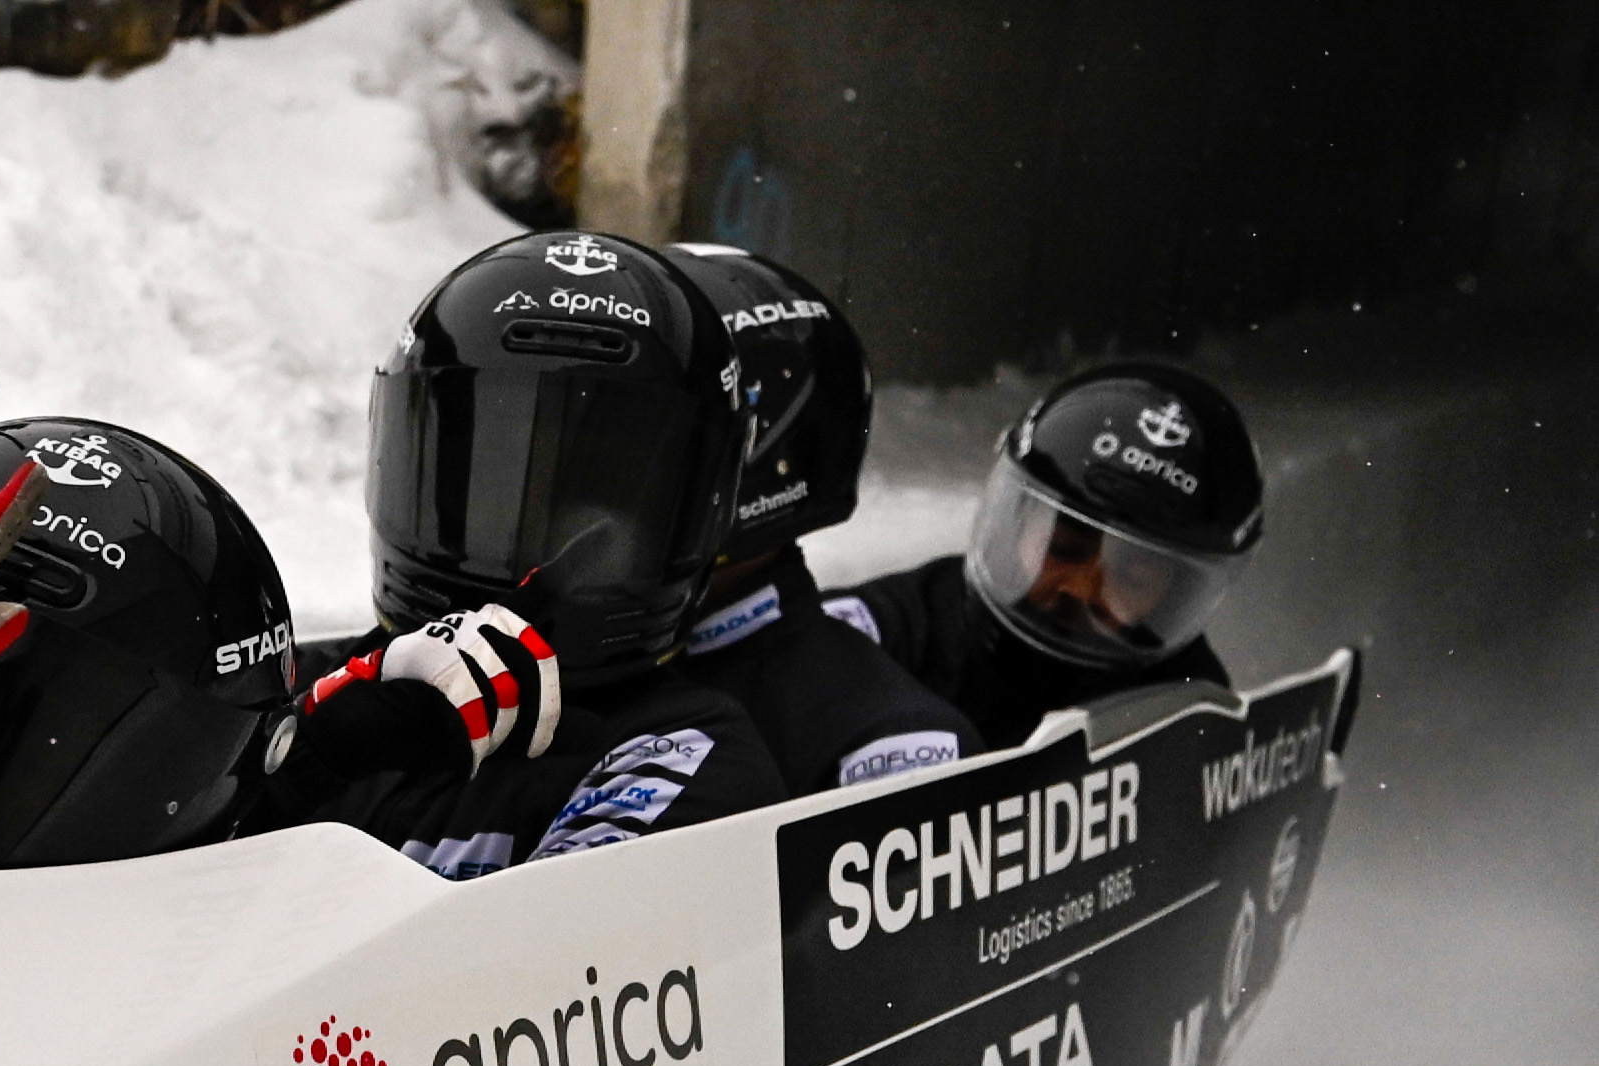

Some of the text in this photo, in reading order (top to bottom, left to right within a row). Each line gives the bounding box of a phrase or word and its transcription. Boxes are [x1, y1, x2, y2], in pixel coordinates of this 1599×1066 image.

[549, 291, 651, 328] aprica
[33, 437, 123, 480] KIBAG
[738, 480, 809, 520] schmidt
[32, 505, 127, 570] rica
[827, 761, 1140, 951] SCHNEIDER
[978, 907, 1053, 964] Logistics
[1056, 892, 1095, 932] since
